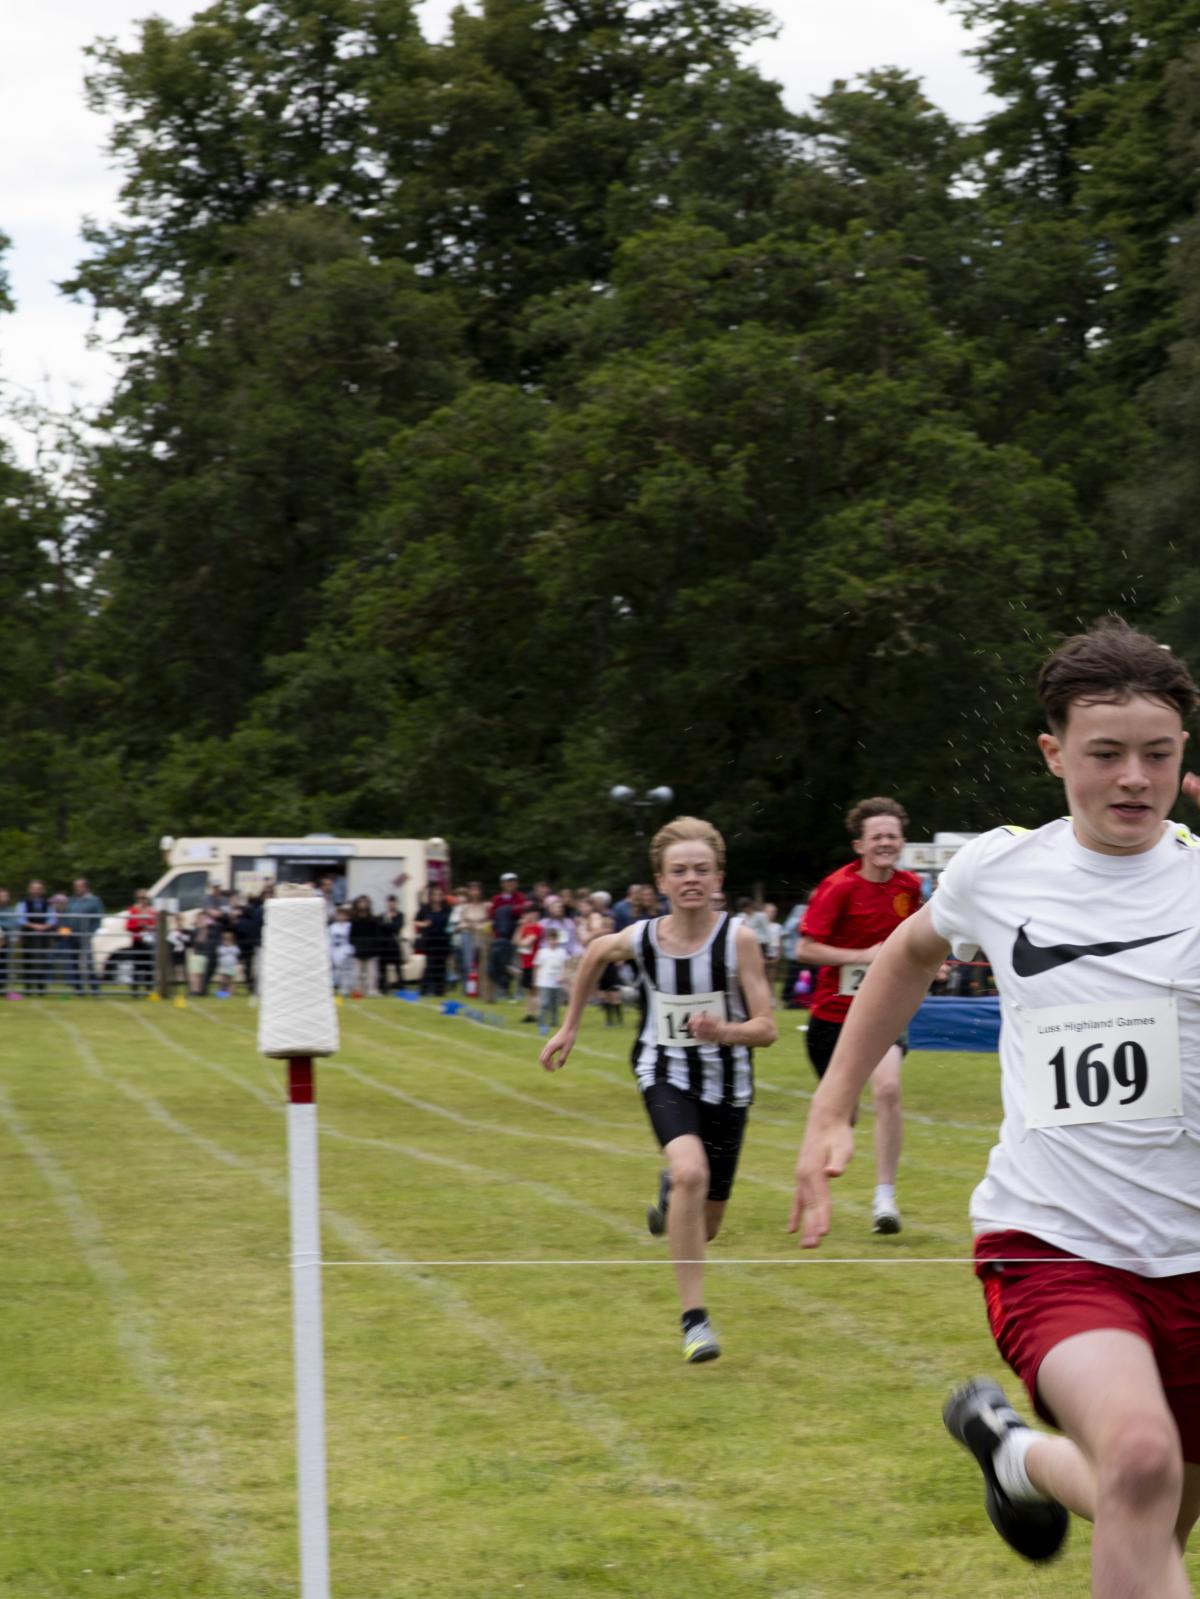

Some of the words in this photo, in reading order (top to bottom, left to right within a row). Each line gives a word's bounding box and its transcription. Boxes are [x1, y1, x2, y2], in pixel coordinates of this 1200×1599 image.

[663, 1009, 708, 1040] 14
[1038, 1024, 1061, 1034] Luss
[1064, 1019, 1113, 1032] Highland
[1117, 1017, 1155, 1027] Games
[1048, 1040, 1148, 1109] 169
